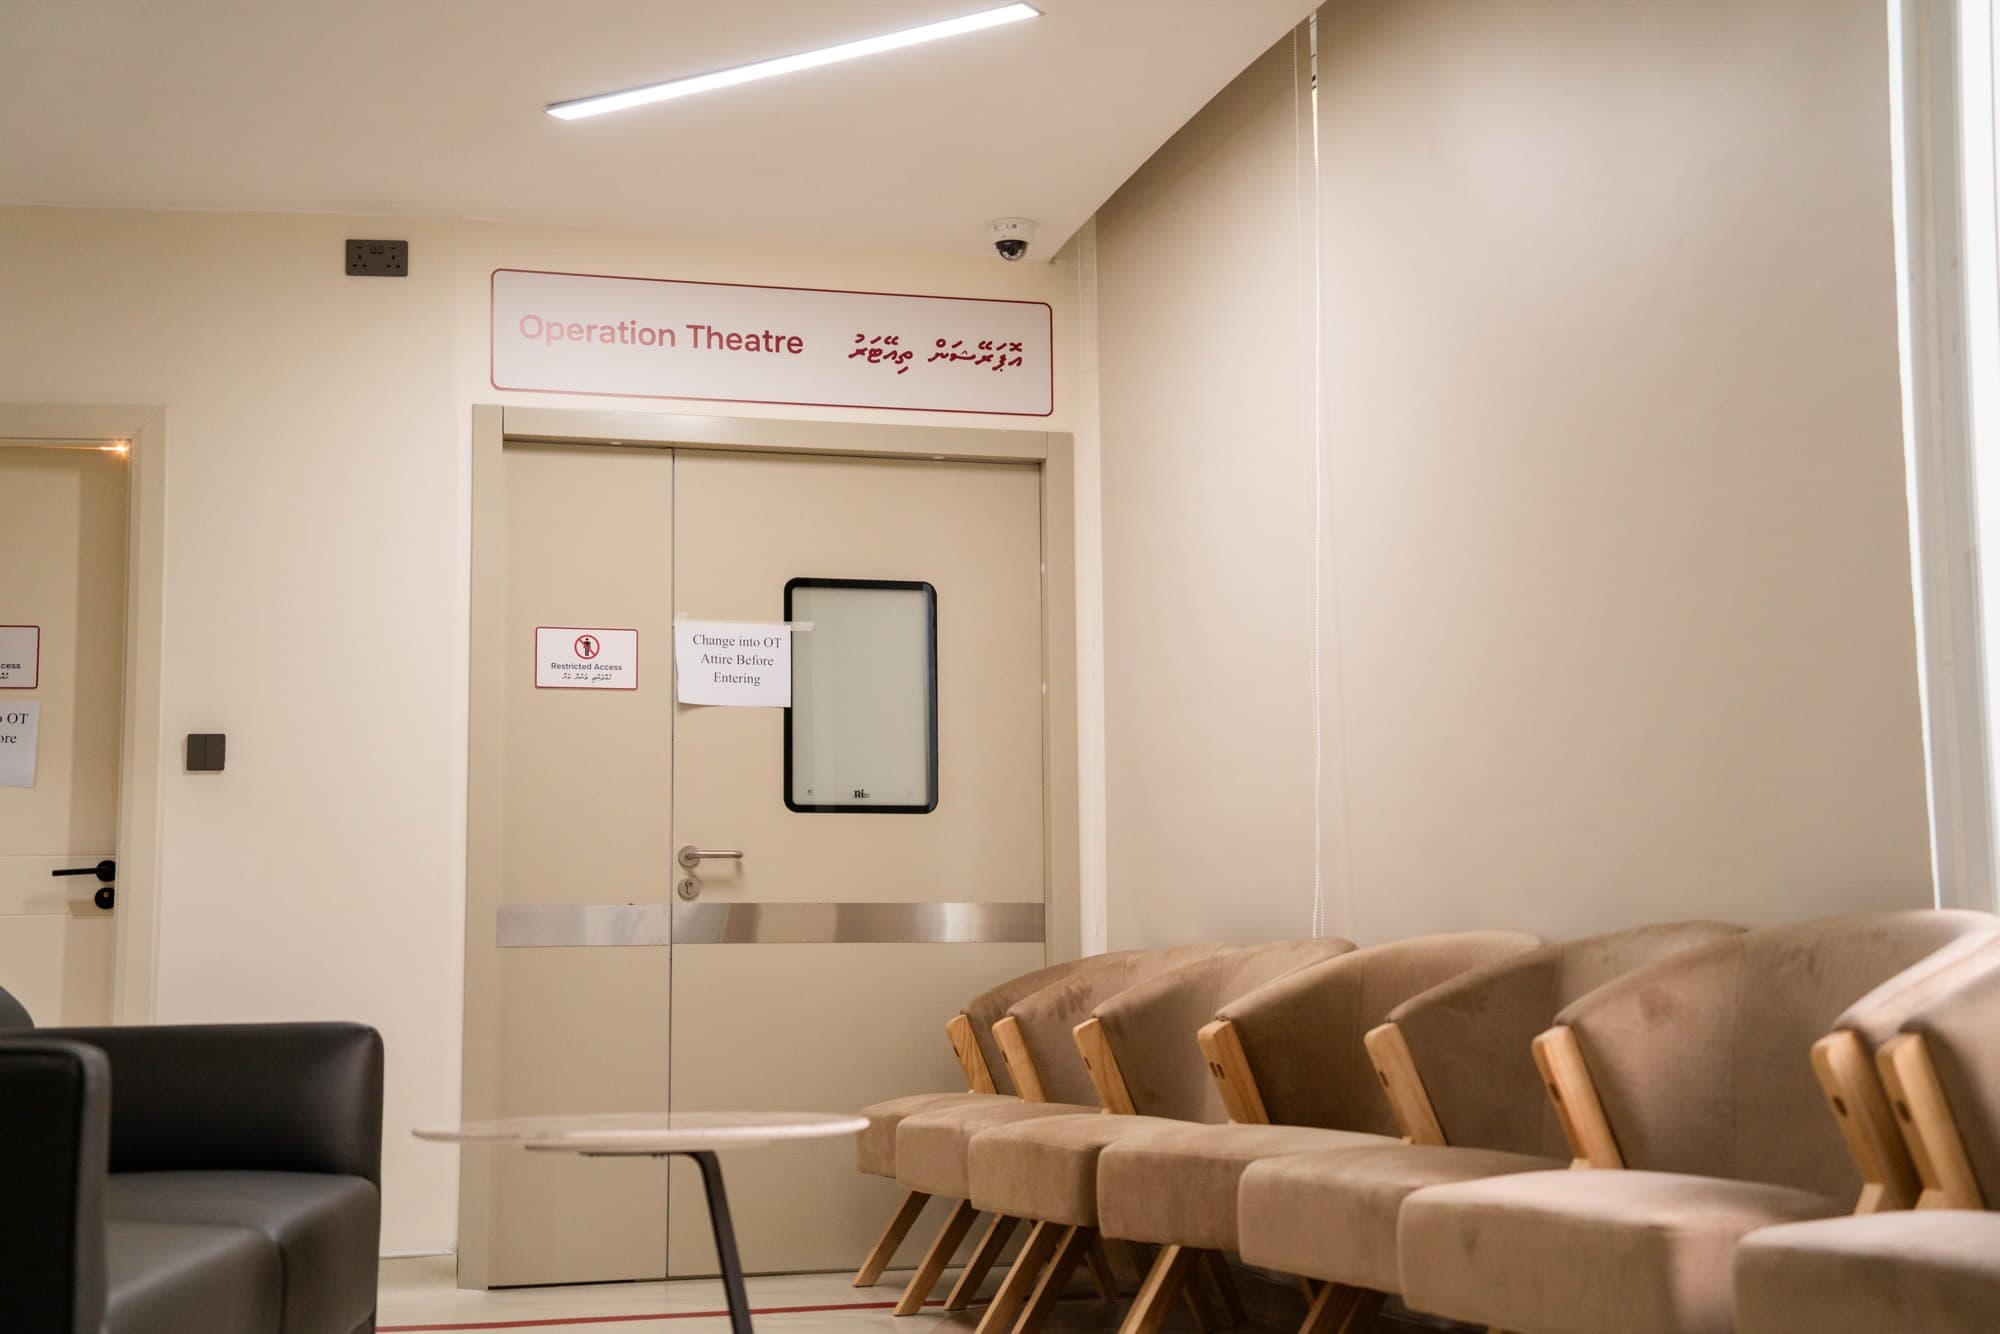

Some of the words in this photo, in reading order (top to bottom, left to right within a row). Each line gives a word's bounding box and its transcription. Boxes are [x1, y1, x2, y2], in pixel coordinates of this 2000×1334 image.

[519, 314, 675, 347] Operation
[685, 324, 805, 354] Theatre
[692, 633, 736, 649] Change
[738, 635, 761, 648] into
[763, 636, 782, 649] OT
[550, 662, 592, 671] Restricted
[593, 663, 623, 671] Access
[700, 652, 734, 665] Attire
[736, 653, 775, 667] Before
[713, 671, 761, 687] Entering
[7, 712, 29, 724] OT
